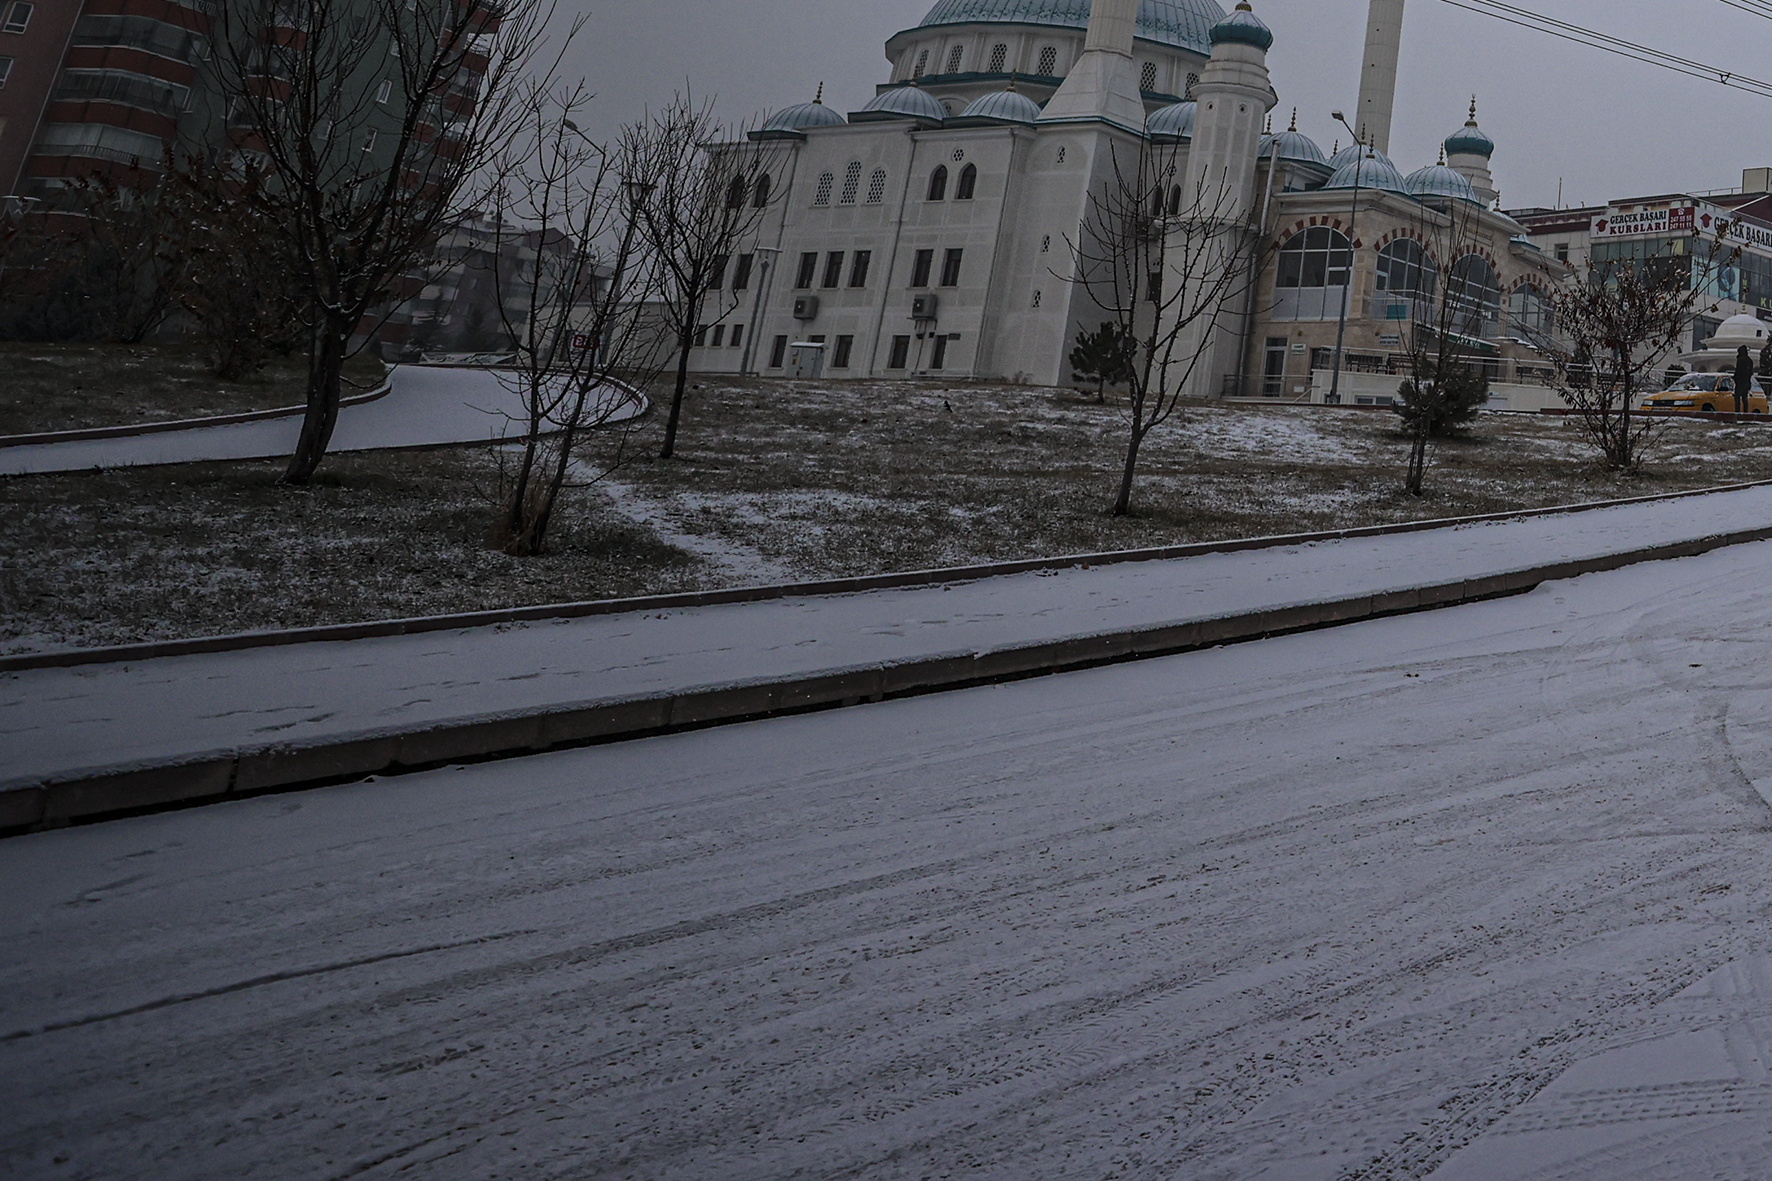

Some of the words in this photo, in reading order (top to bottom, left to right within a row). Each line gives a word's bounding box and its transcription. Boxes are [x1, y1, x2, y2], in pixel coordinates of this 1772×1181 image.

[1610, 213, 1638, 225] GERÇEK
[1640, 210, 1667, 223] BAŞARI
[1609, 221, 1667, 235] KURSLARI
